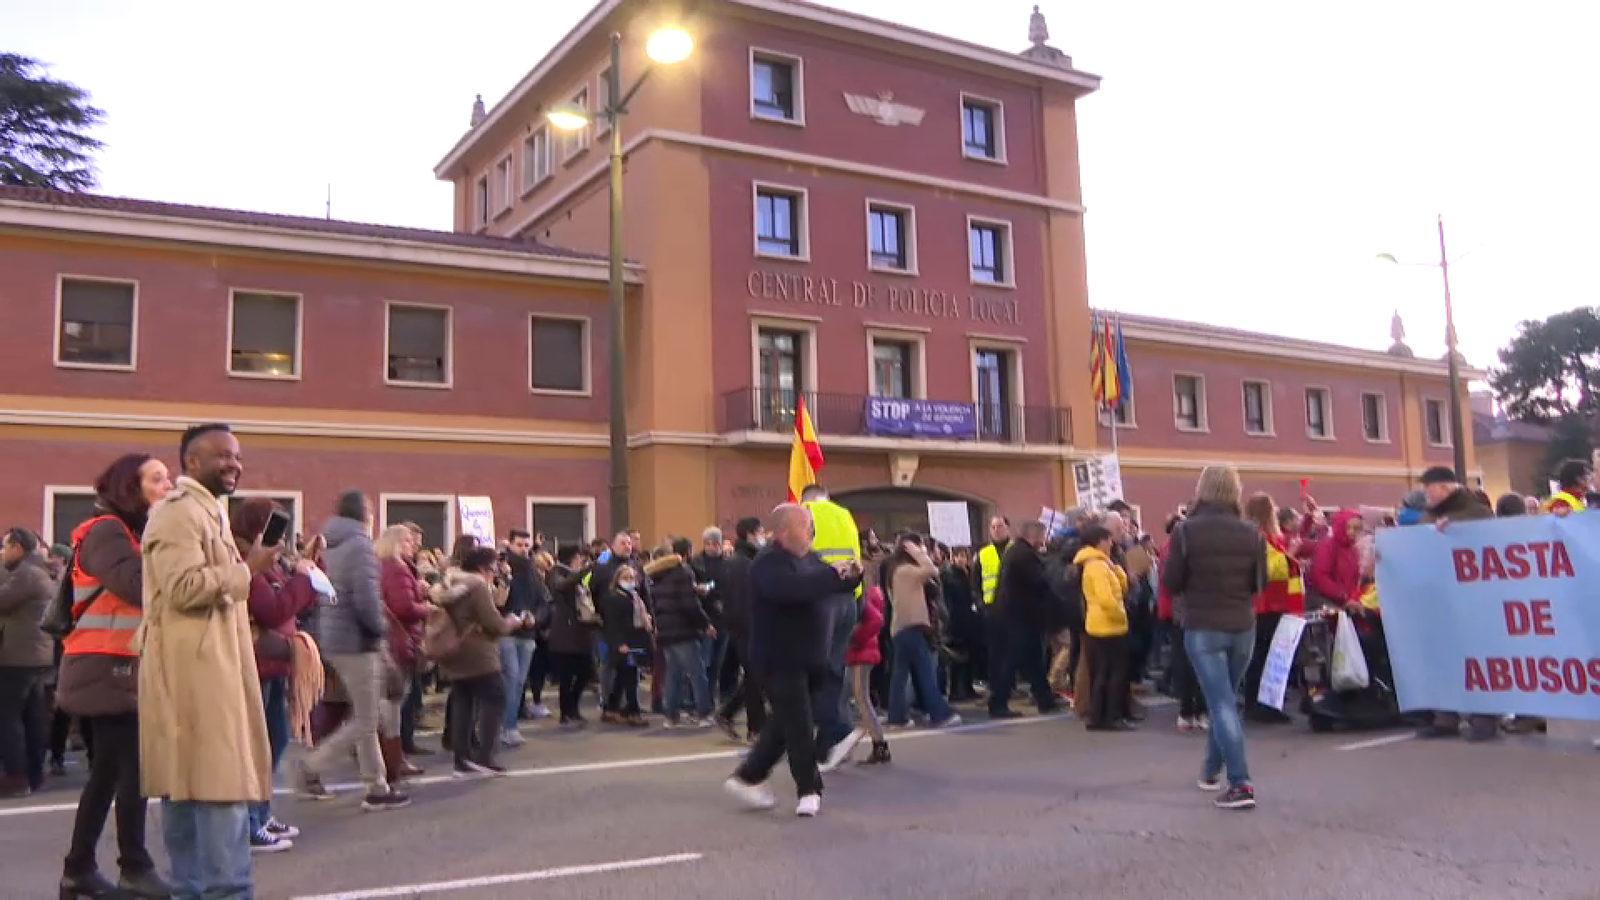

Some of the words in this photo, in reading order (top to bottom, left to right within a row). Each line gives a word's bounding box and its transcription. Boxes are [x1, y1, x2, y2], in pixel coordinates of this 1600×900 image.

[747, 270, 842, 306] CENTRAL
[889, 285, 960, 319] POLICIA
[967, 296, 1023, 326] LOCAL
[871, 400, 911, 420] STOP
[1451, 540, 1576, 583] BASTA
[1502, 599, 1556, 636] DE
[1464, 656, 1600, 696] ABUSOS
